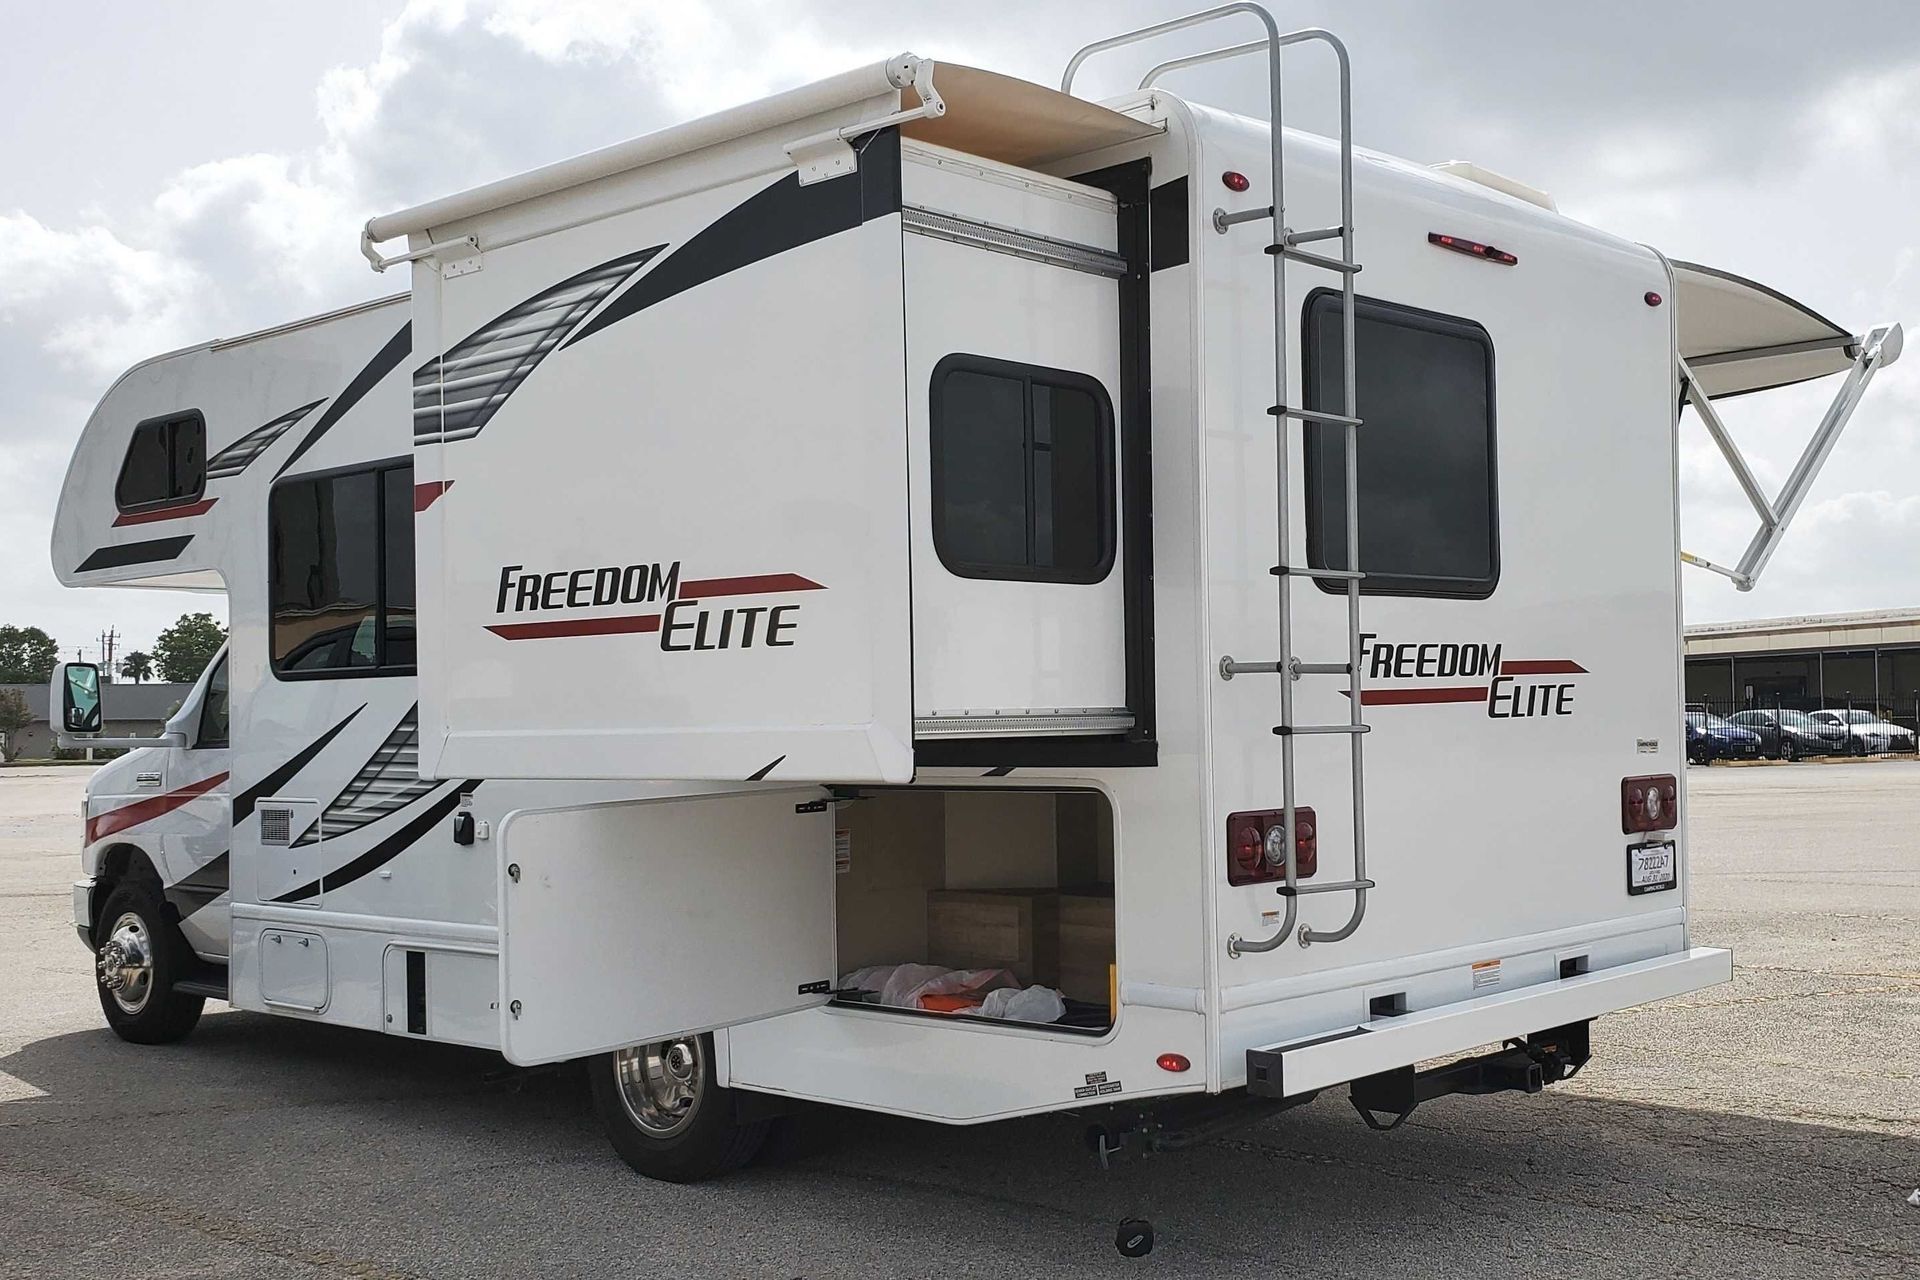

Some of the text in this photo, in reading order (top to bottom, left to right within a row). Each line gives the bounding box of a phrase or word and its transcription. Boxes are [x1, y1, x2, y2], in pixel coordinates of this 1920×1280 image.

[496, 561, 681, 614] FREEDOM
[660, 600, 800, 652] ELITE
[1359, 634, 1501, 678] FREEDOM
[1488, 676, 1576, 718] ELITE
